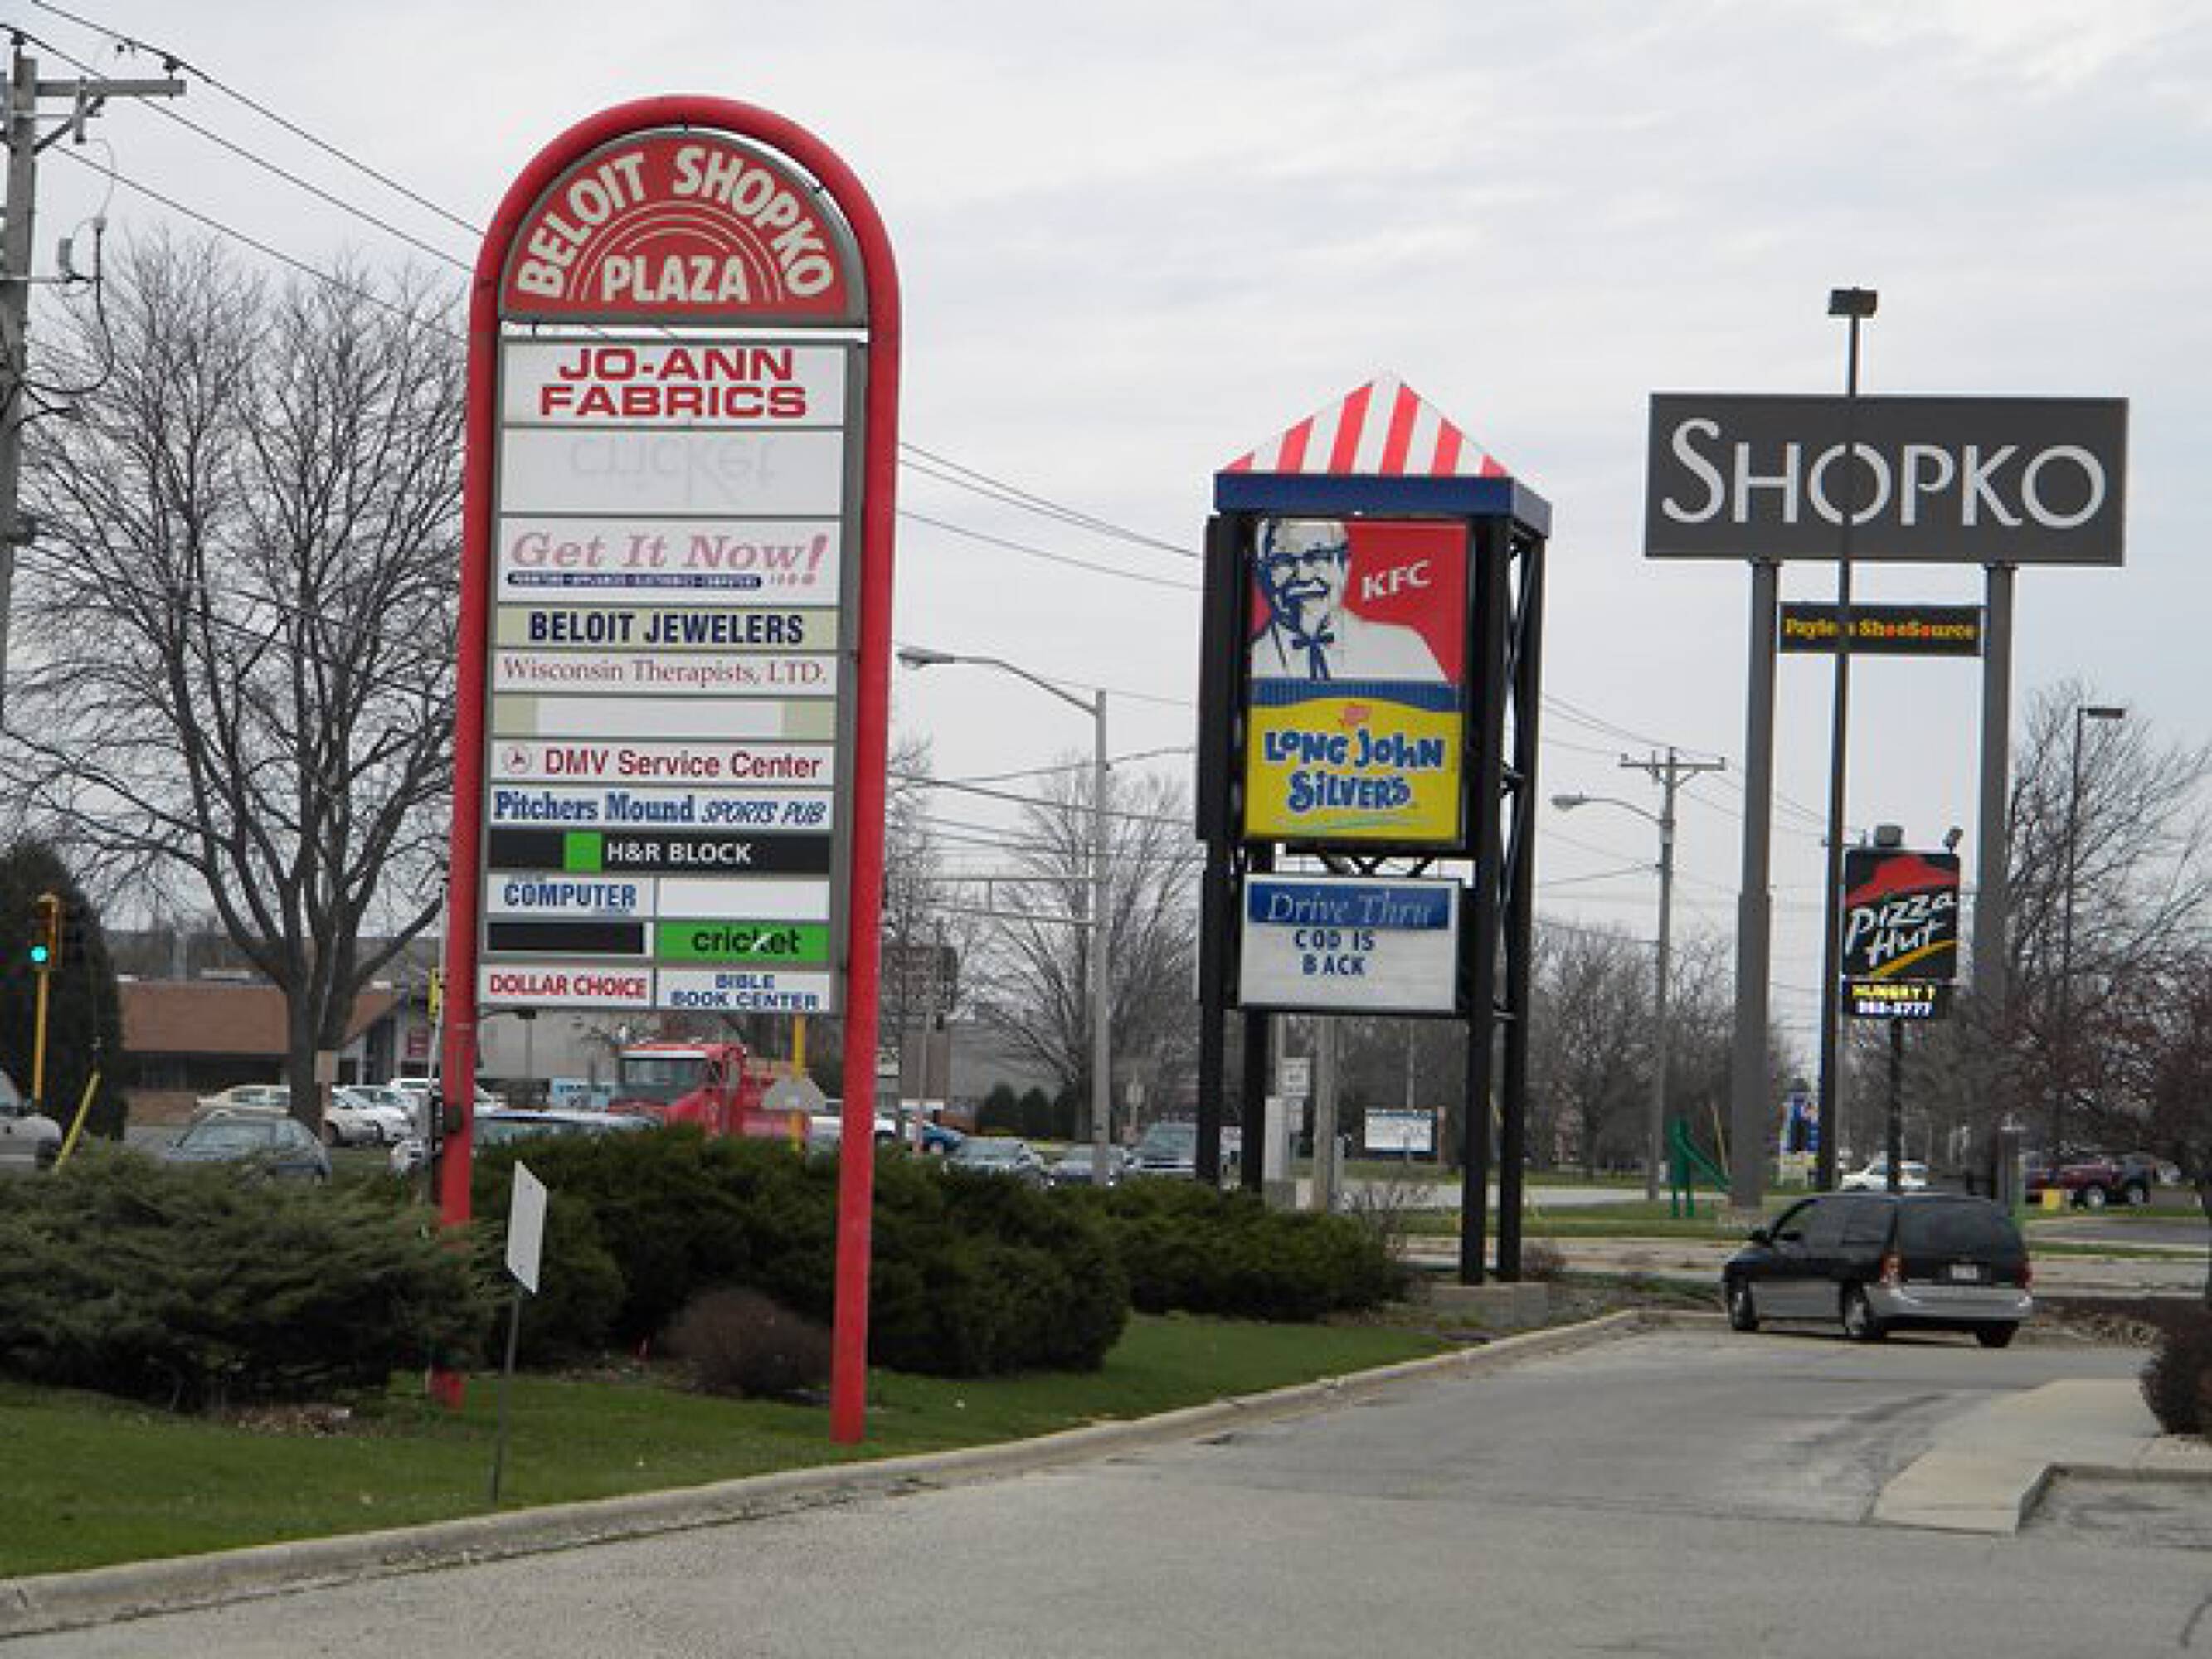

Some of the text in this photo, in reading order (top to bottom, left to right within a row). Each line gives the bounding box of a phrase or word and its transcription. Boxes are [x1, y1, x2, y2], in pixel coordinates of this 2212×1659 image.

[517, 145, 834, 298] BELOIT SHOPKO
[601, 255, 749, 302] PLAZA
[559, 348, 793, 382] JO-ANN
[541, 387, 807, 416] FABRICS
[1660, 416, 2107, 529] SHOPKO
[510, 531, 829, 572] Get It Now!
[1360, 560, 1432, 601] KFC
[528, 611, 805, 645] BELOIT JEWELERS
[503, 657, 828, 688] Wisconsin Therapists, LTD.
[544, 750, 823, 779] DMV Service Center
[493, 791, 828, 826] Pitchers Mound SPORTS PUB
[606, 841, 751, 865] H&R BLOCK
[503, 883, 637, 907] COMPUTER
[1267, 890, 1432, 927] Drive Thru
[1845, 890, 1957, 957] Pizza
[690, 925, 802, 956] cricket
[1294, 929, 1376, 951] COD IS
[1865, 917, 1947, 967] Hut
[1301, 954, 1367, 976] BACK
[489, 974, 648, 999] DOLLAR CHOICE
[715, 974, 775, 990] BIBLE
[670, 992, 819, 1010] BOOK CENTER
